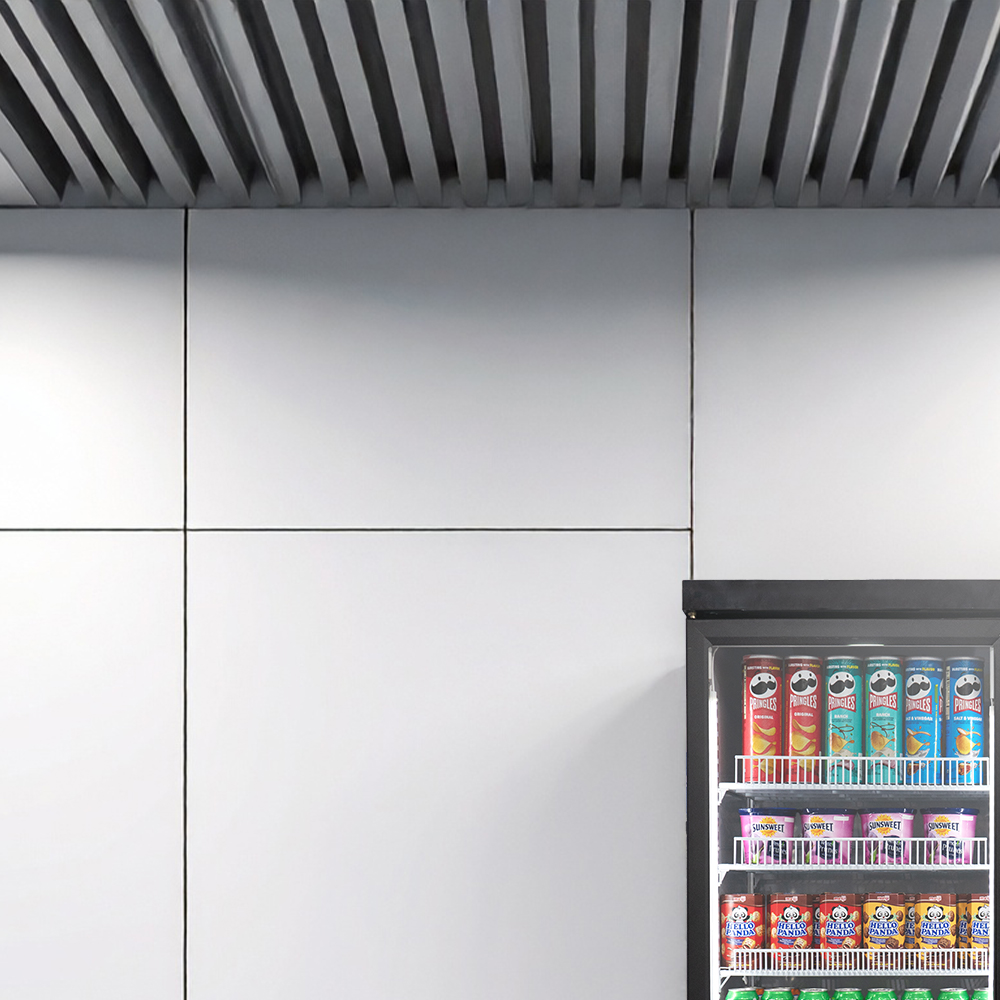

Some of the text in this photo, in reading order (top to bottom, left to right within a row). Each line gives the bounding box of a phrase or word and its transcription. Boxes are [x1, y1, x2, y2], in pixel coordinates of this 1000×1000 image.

[750, 697, 777, 711] PRINGLES
[790, 694, 817, 709] PRINGLES
[828, 696, 855, 710] PRINGLES
[869, 694, 897, 708] PRINGLES
[954, 697, 981, 712] PRINGLES
[752, 824, 784, 833] SUNSWEET
[804, 823, 833, 832] SUNSWEET
[869, 821, 901, 831] SUNSWEET
[928, 822, 959, 831] SUNSWEET
